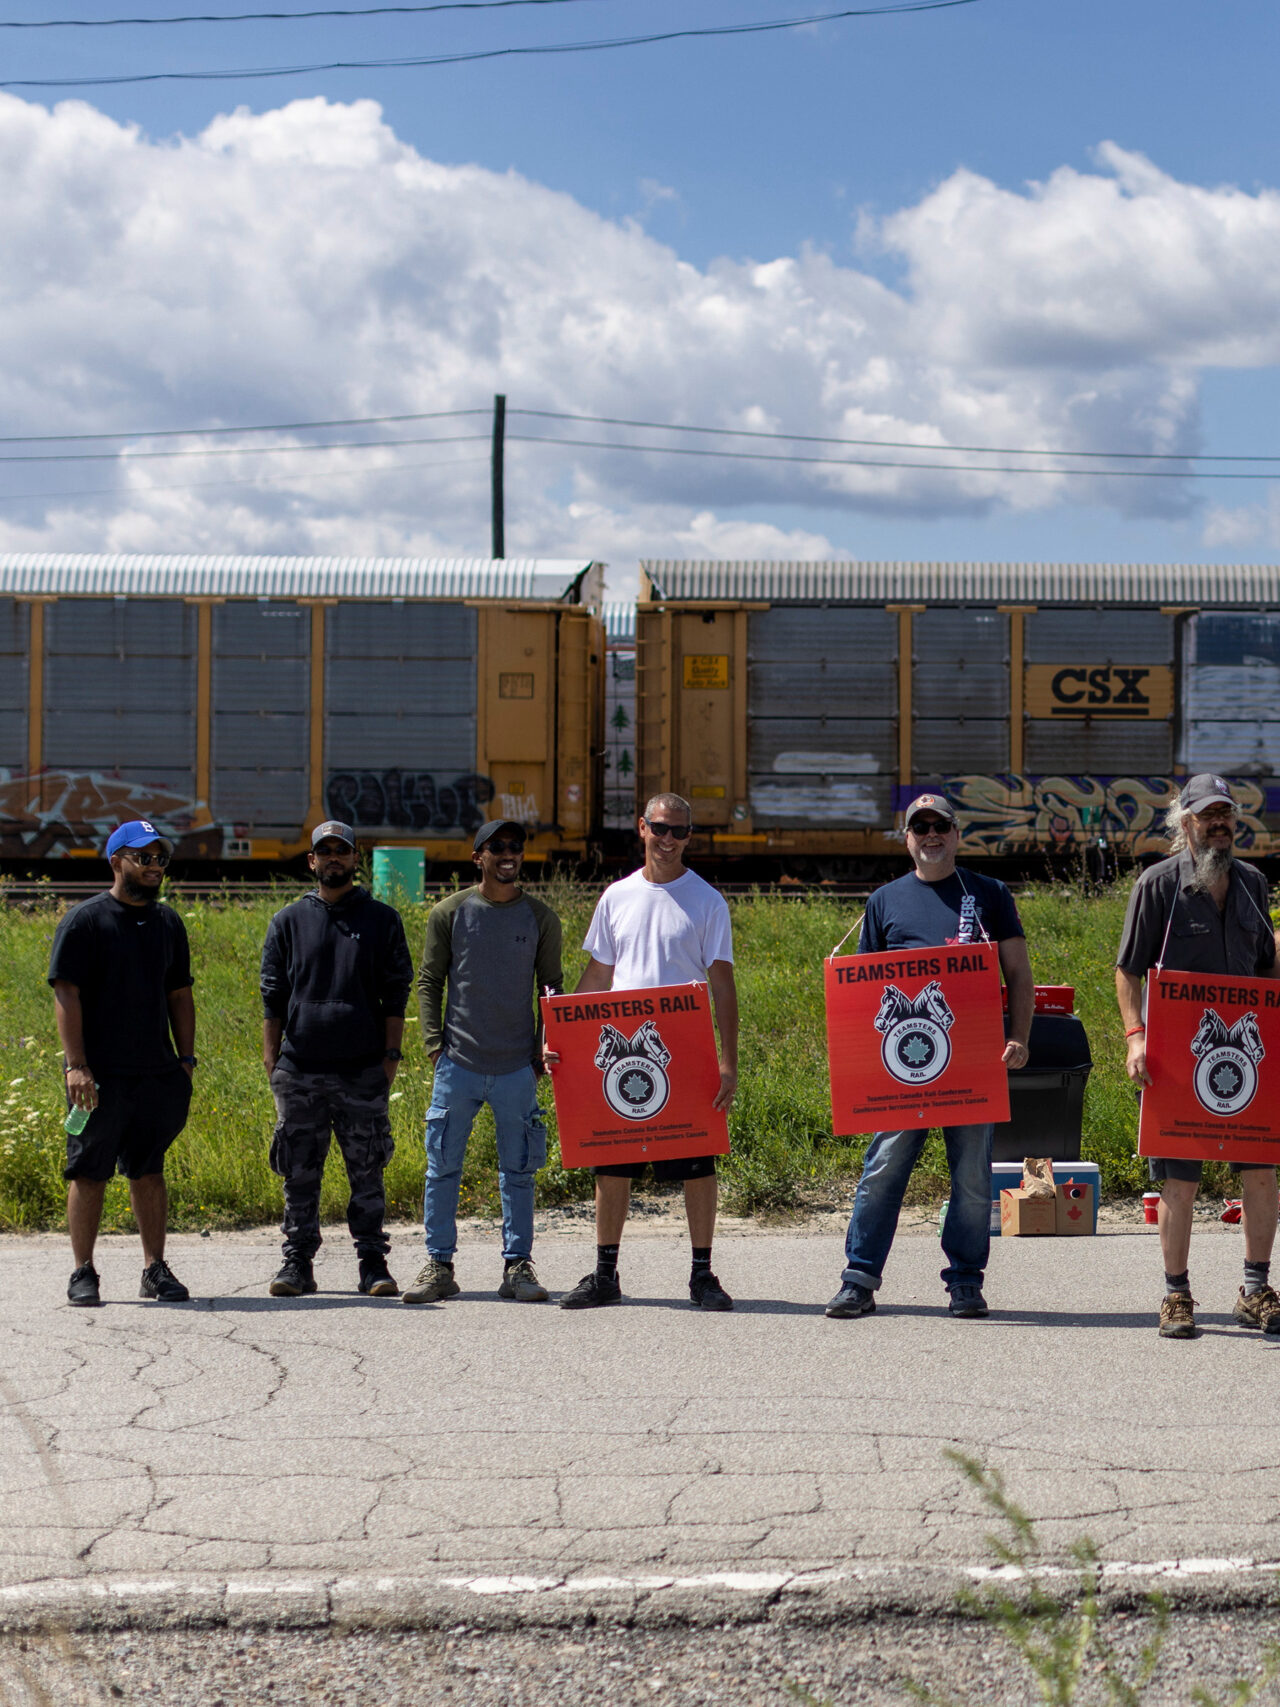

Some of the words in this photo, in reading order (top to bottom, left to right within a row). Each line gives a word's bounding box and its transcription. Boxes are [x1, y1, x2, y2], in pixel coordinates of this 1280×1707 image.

[1051, 668, 1149, 704] CSX
[140, 821, 154, 833] B
[836, 958, 941, 984] TEAMSTERS
[947, 955, 988, 973] RAIL
[1159, 982, 1259, 1007] TEAMSTERS
[552, 999, 655, 1023] TEAMSTERS
[660, 994, 700, 1013] RAIL
[893, 1022, 936, 1038] TEAMSTERS
[613, 1060, 655, 1075] TEAMSTERS
[1207, 1051, 1247, 1067] TEAMSTERS
